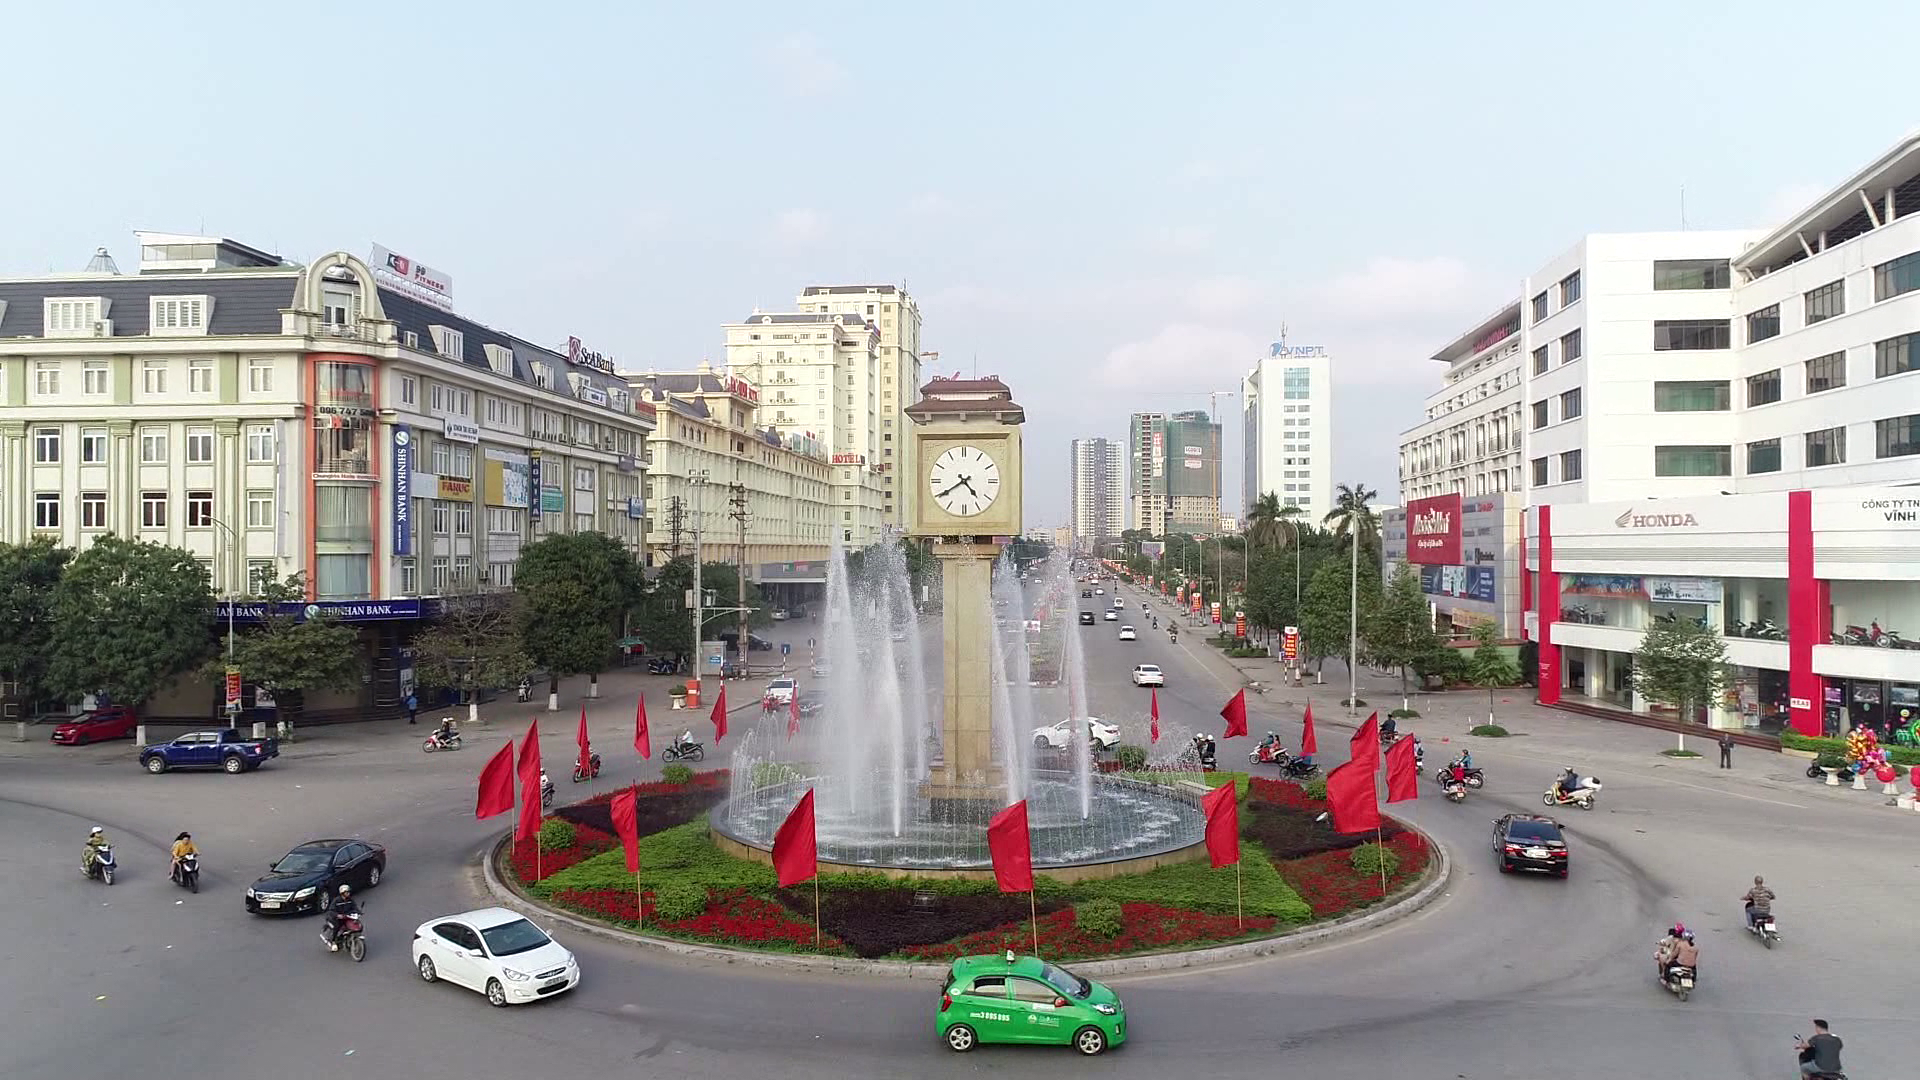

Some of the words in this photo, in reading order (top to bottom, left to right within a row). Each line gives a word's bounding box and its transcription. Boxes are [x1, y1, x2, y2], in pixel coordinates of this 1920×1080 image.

[831, 454, 861, 464] HOTEL
[397, 448, 407, 493] SHINHAN
[397, 494, 407, 522] BANK
[1861, 498, 1890, 509] CÔNG
[1891, 499, 1905, 508] TY
[1632, 513, 1699, 528] HONDA
[1883, 509, 1917, 522] VĨNH
[236, 607, 264, 617] BANK
[366, 605, 392, 616] BANK
